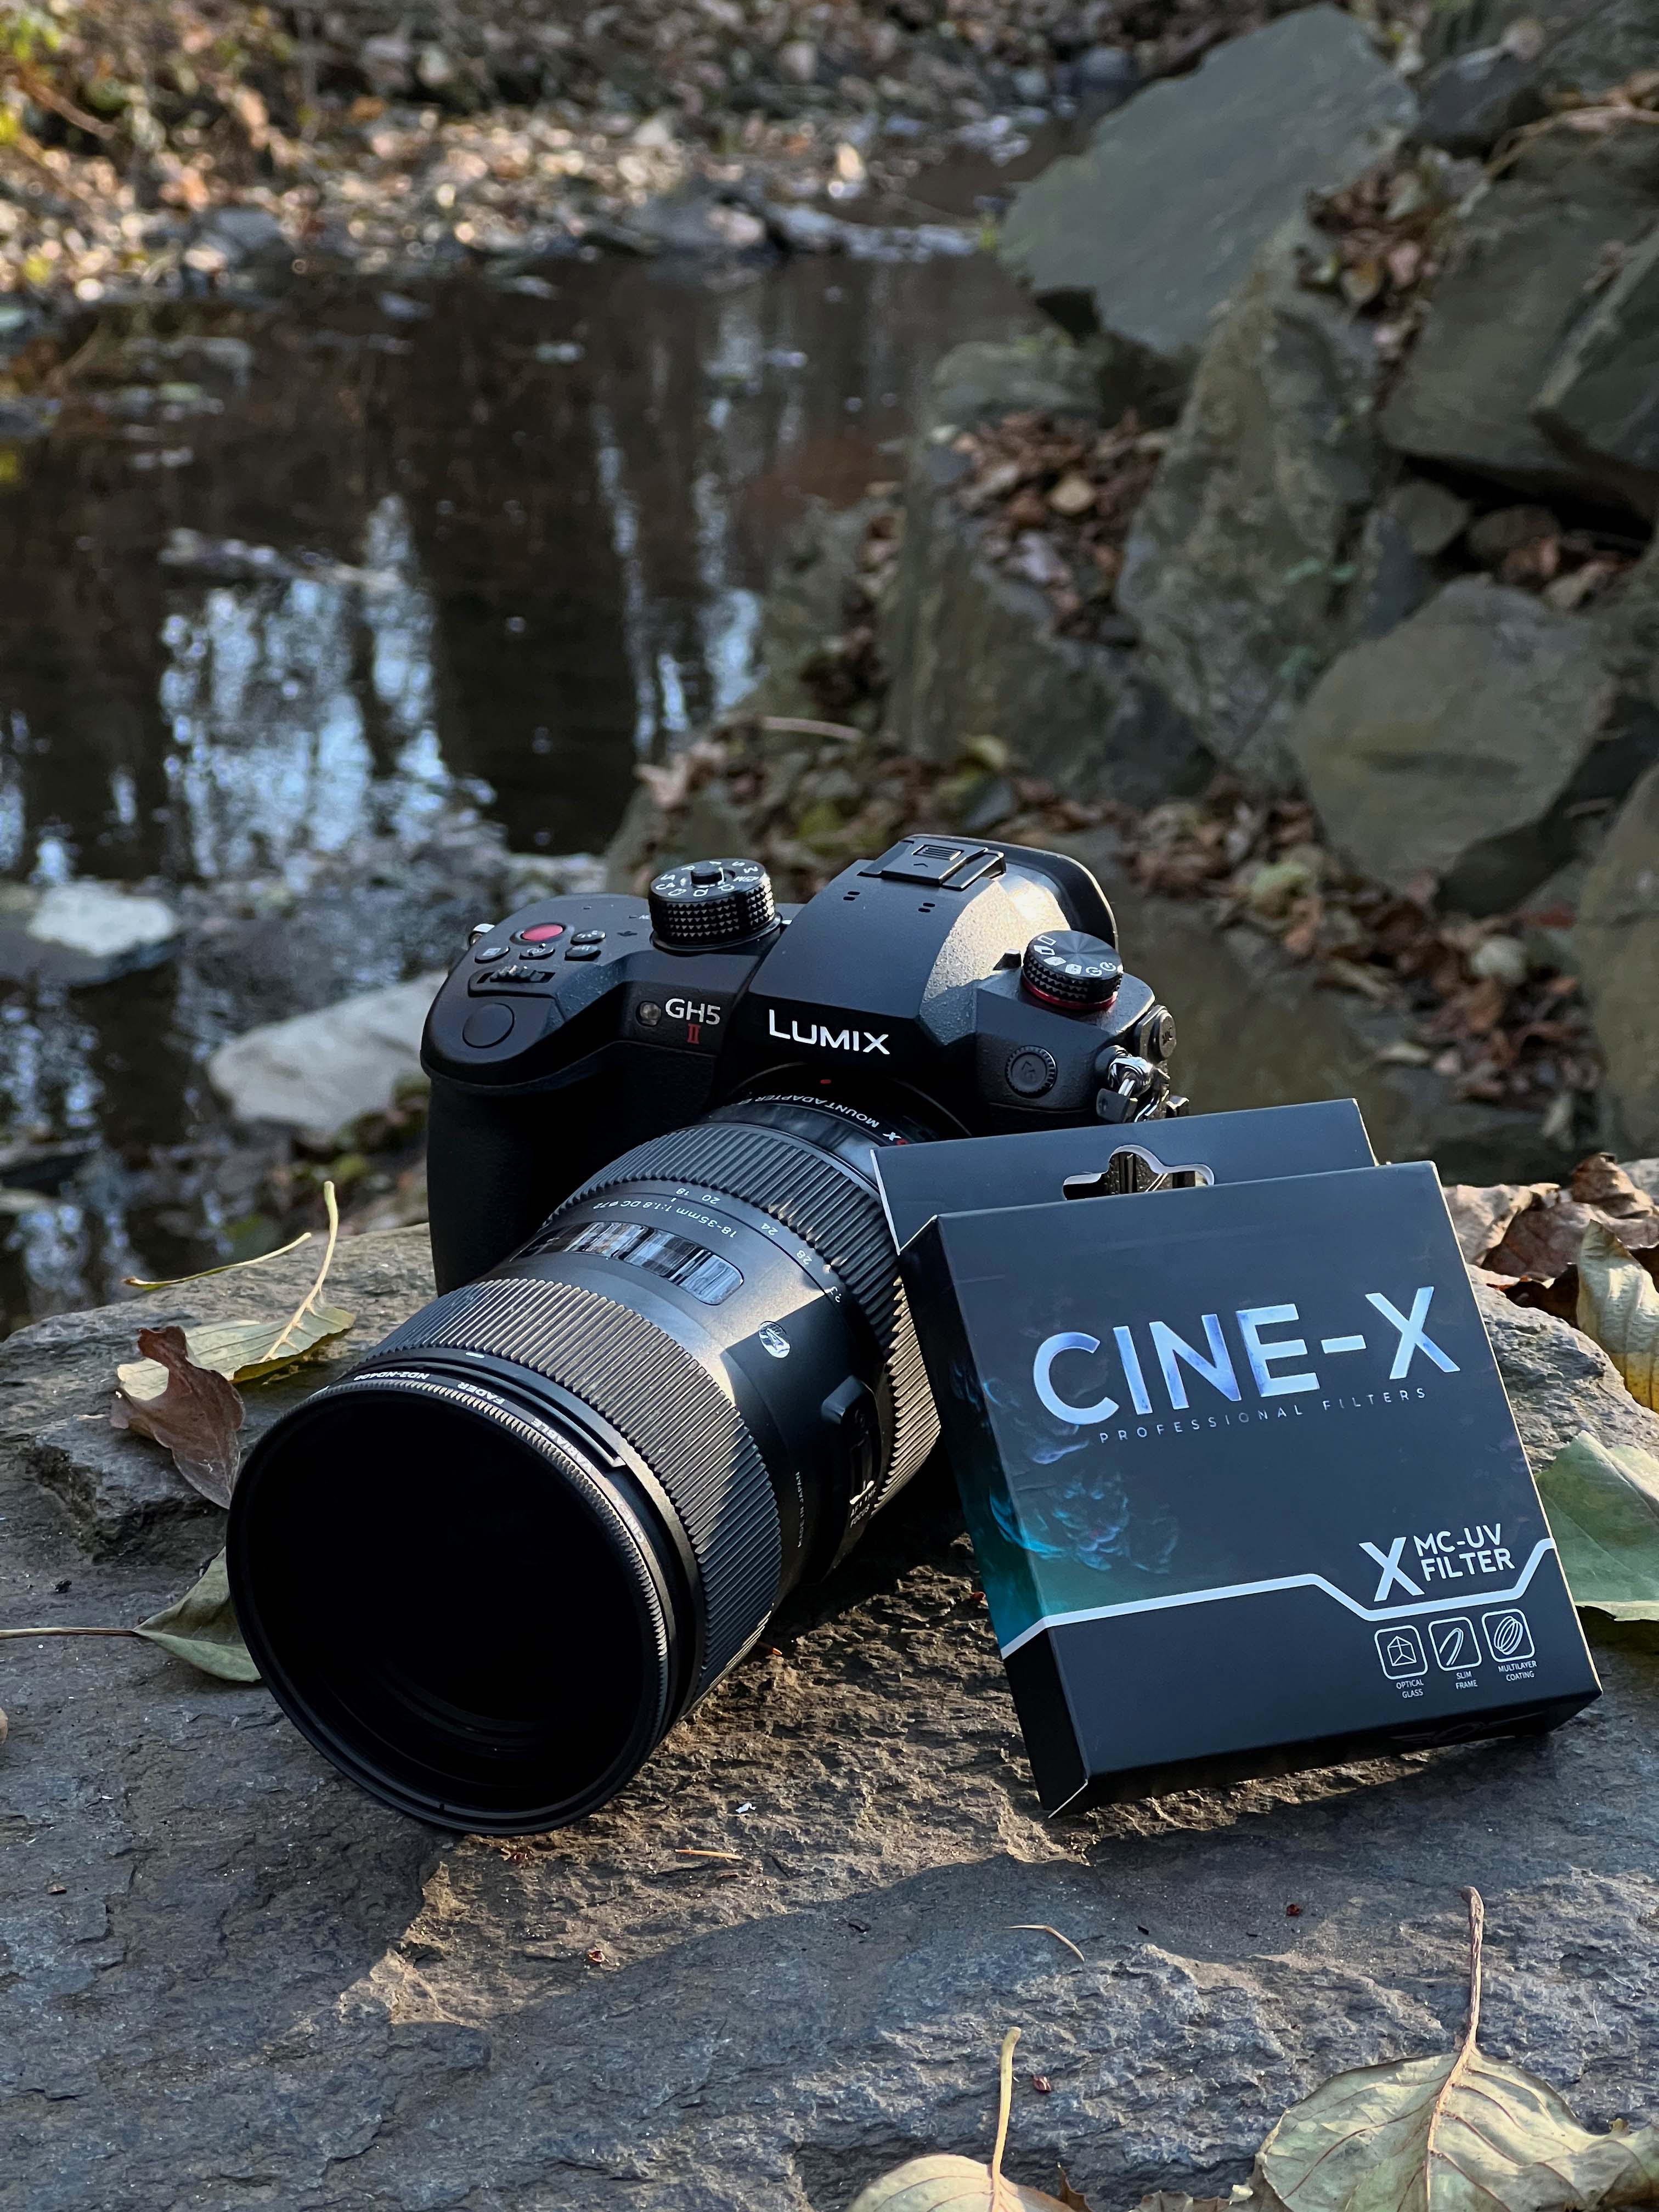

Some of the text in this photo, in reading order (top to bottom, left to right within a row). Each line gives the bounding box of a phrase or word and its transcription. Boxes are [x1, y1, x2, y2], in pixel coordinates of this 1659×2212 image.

[665, 998, 720, 1024] GH5
[769, 1008, 890, 1055] LUMIX
[755, 1095, 828, 1104] ADAPTER
[825, 1102, 879, 1127] MOUNT
[702, 1194, 720, 1204] 20
[676, 1207, 737, 1238] 18-35mm
[761, 1223, 778, 1235] 24
[797, 1250, 812, 1265] 28
[1033, 1286, 1461, 1425] CINE-X
[457, 1381, 505, 1405] FADER
[1099, 1387, 1427, 1443] PROFESSIONAL FILTERS
[531, 1418, 593, 1472] VARIABLE
[1358, 1523, 1501, 1602] X MC-UV
[1421, 1548, 1515, 1581] FILTER
[1456, 1671, 1472, 1680] SLIM
[1498, 1660, 1537, 1673] MULTILAYER
[1505, 1670, 1534, 1681] COATING
[1396, 1679, 1424, 1690] OPTICAL
[1402, 1689, 1424, 1699] GLASS
[1455, 1679, 1477, 1690] FRAME
